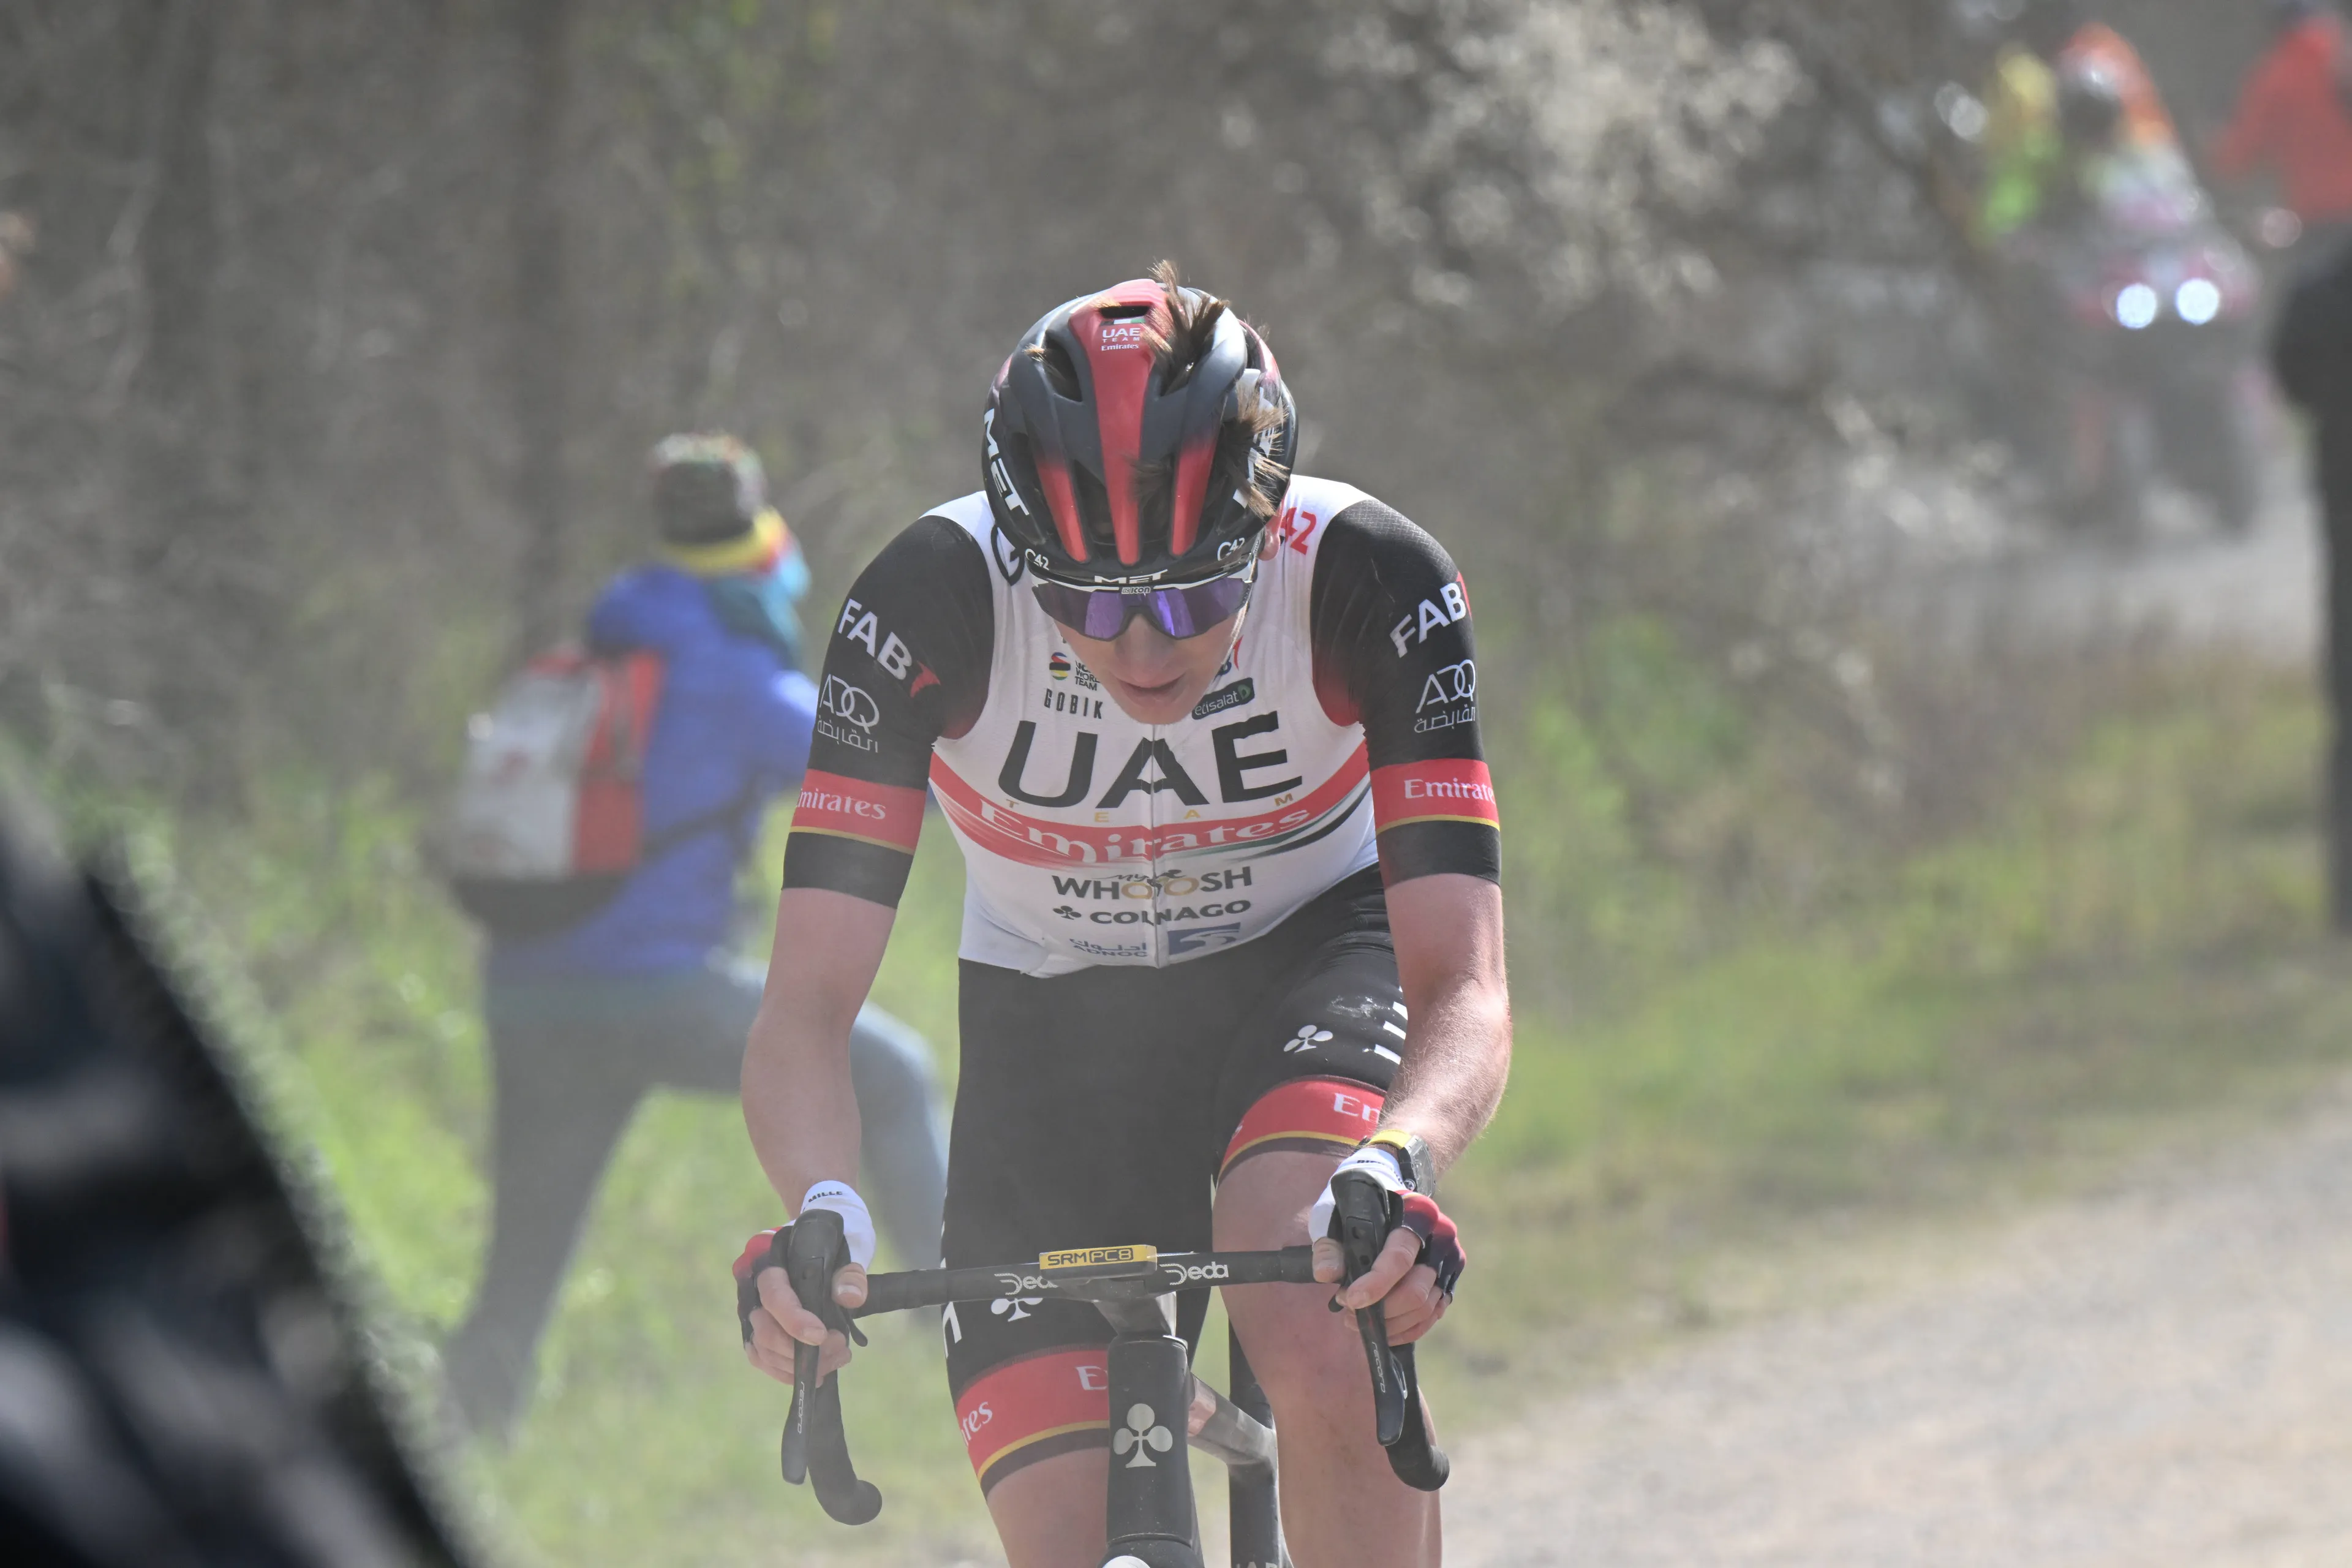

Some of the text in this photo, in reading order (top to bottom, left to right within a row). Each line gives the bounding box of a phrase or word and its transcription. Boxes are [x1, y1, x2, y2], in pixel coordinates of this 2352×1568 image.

[1102, 326, 1141, 338] UAE
[984, 407, 1030, 516] MET
[1279, 507, 1317, 556] 42
[1094, 568, 1168, 584] MET
[1389, 582, 1468, 658] FAB
[837, 598, 913, 680] FAB
[1074, 675, 1098, 692] TEAM
[1043, 687, 1104, 720] GOBIK
[998, 710, 1303, 809] UAE
[795, 788, 887, 820] mirates
[1403, 777, 1496, 806] Emirate
[979, 797, 1311, 864] Emirates
[1051, 865, 1253, 900] WHOOSH
[1089, 899, 1251, 926] COLNAGO
